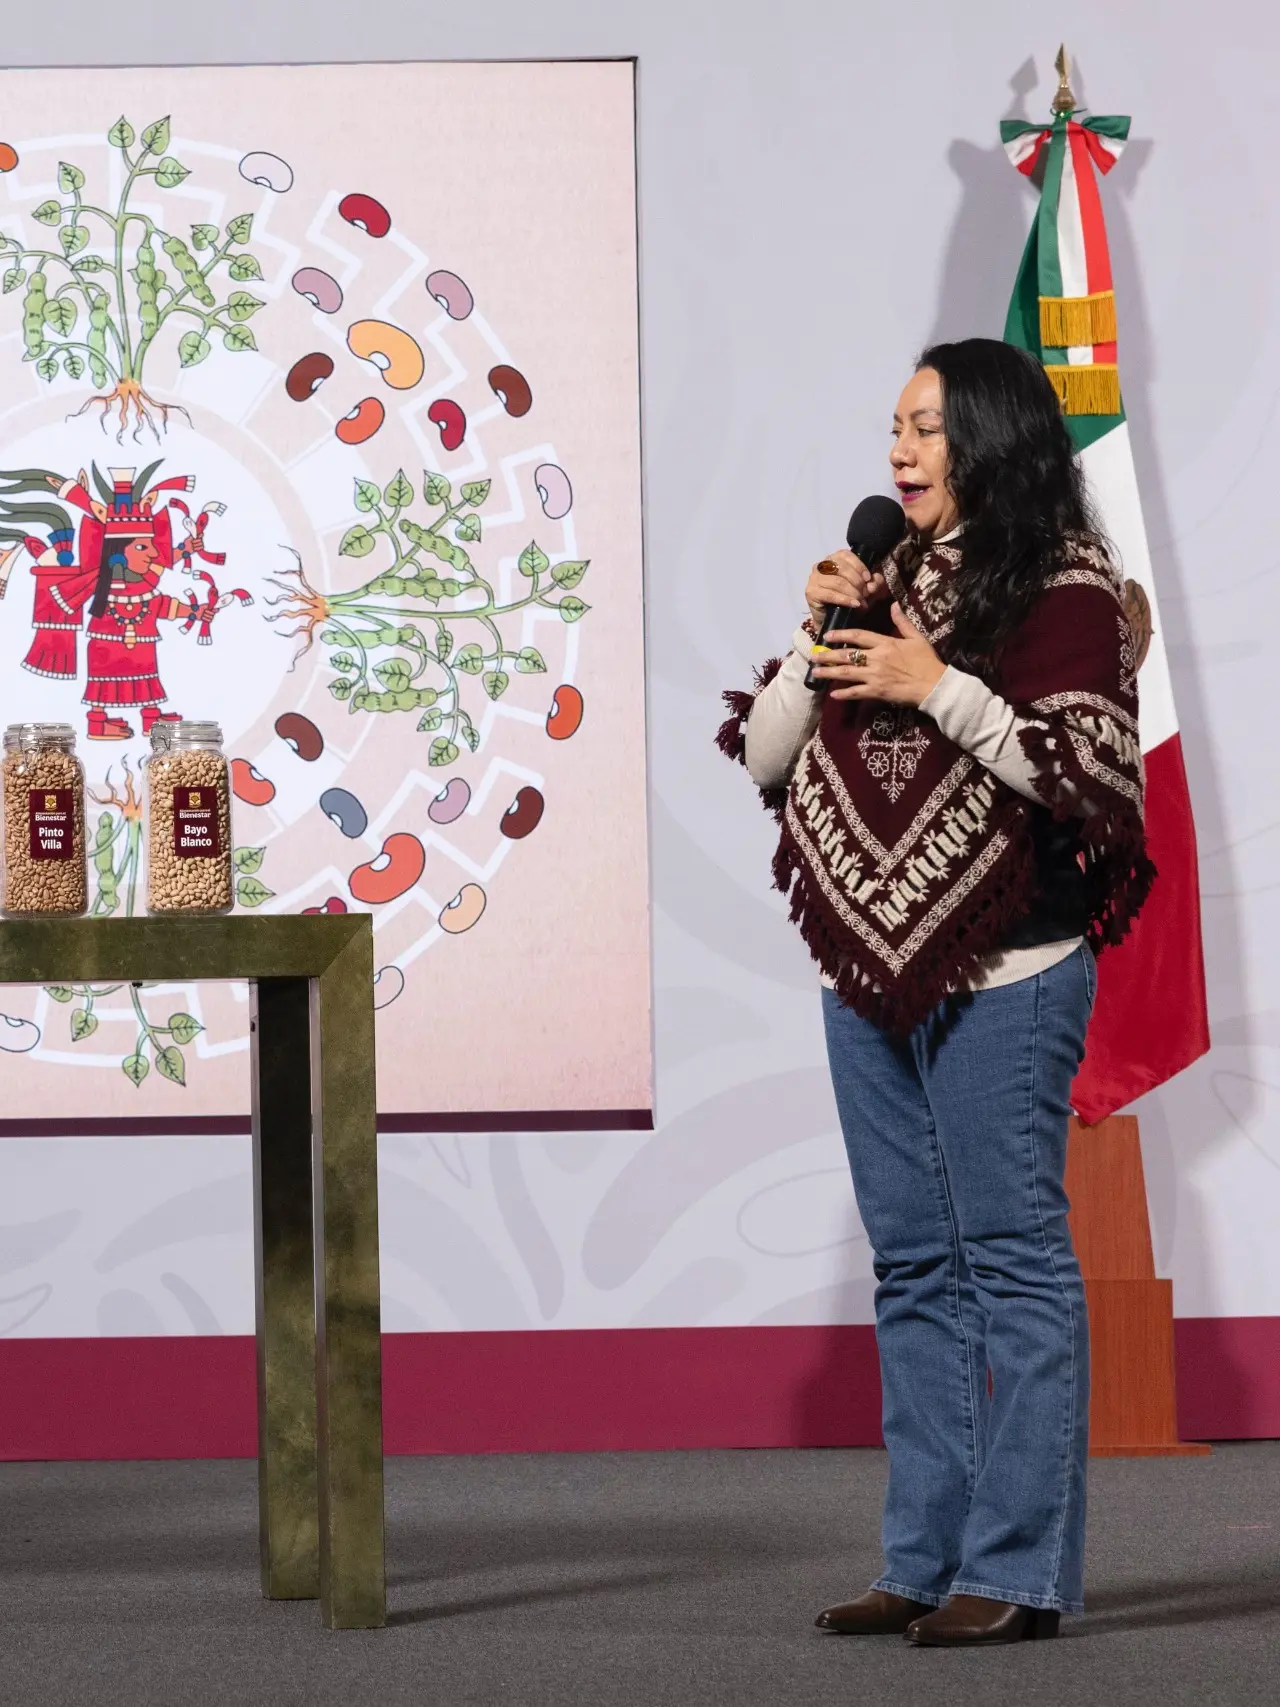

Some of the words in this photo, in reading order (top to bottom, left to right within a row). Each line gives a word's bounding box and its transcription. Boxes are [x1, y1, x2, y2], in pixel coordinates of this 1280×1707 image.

[39, 827, 64, 837] Pinto
[184, 825, 207, 836] Bayo
[41, 839, 62, 849] Villa
[181, 837, 212, 847] Blanco
